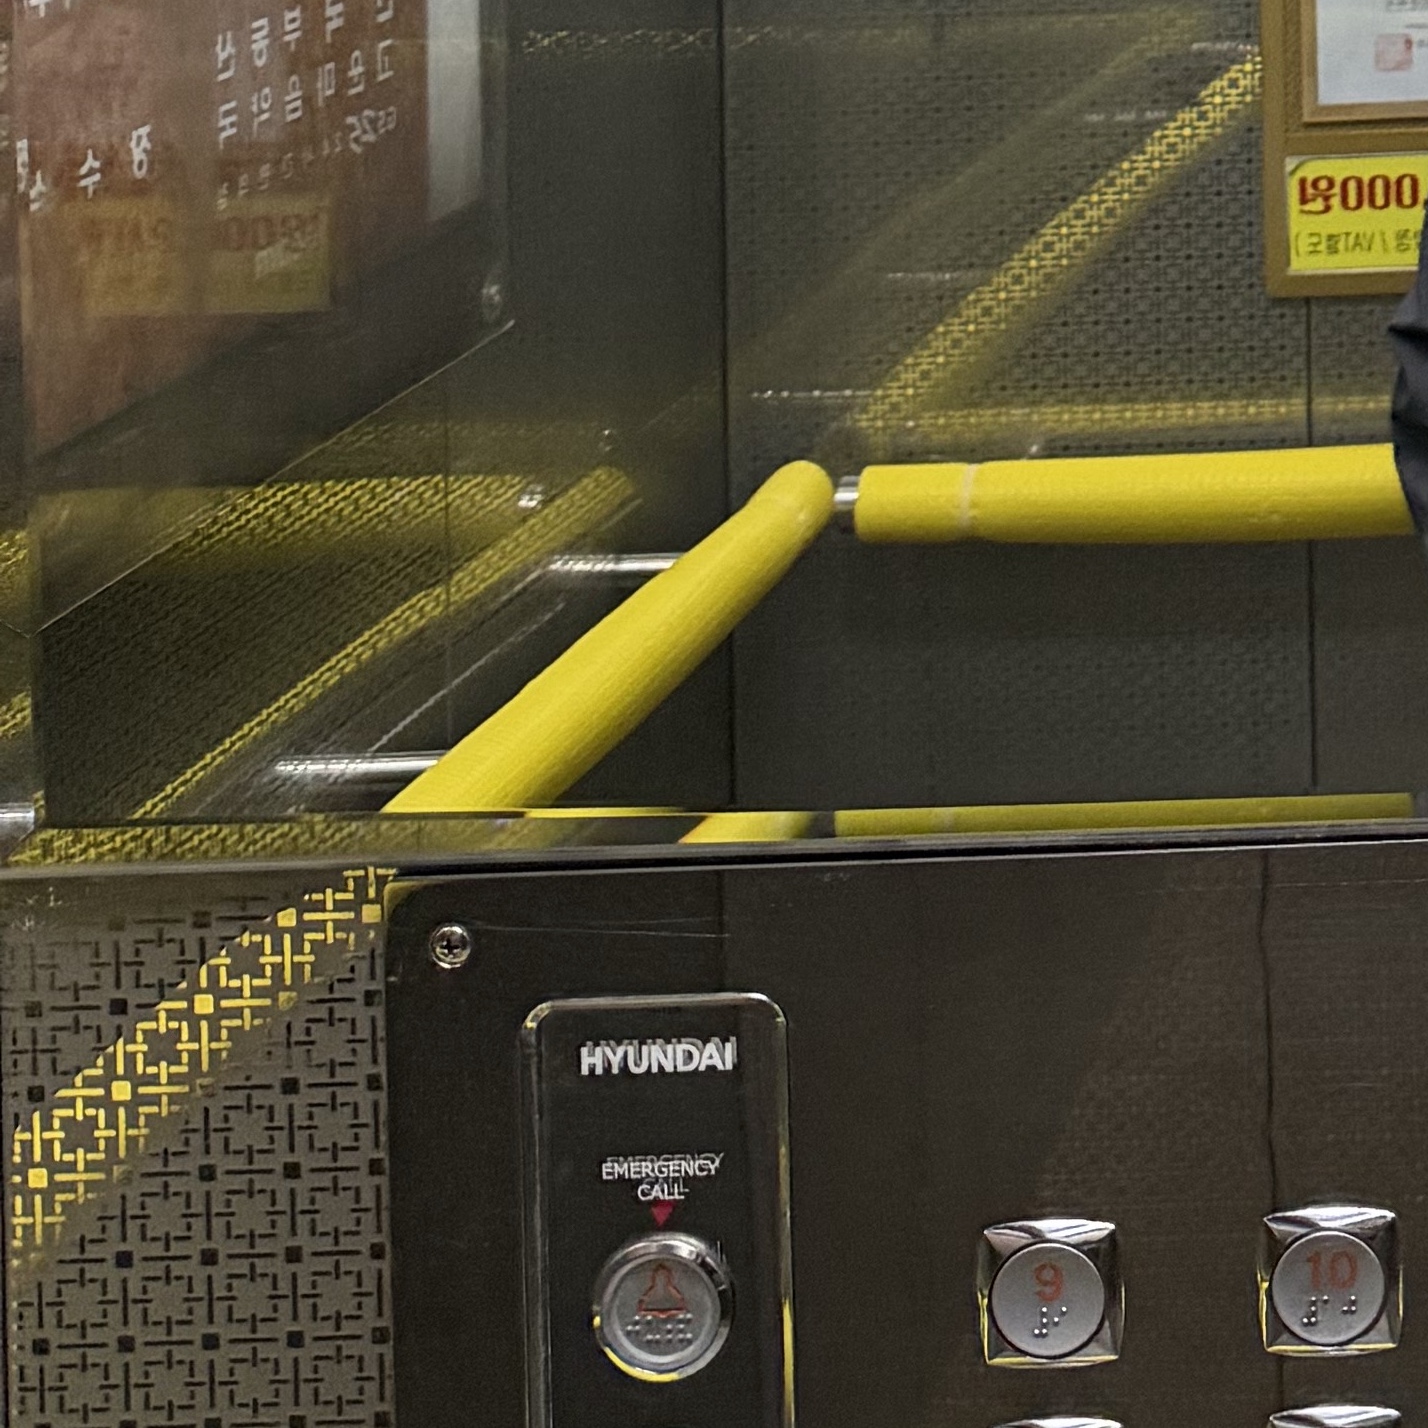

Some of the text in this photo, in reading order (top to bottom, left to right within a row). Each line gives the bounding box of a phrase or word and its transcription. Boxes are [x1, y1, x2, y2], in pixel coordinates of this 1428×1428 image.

[579, 1041, 734, 1076] HYUNDAI
[601, 1159, 720, 1181] EMERGENCY
[637, 1183, 685, 1201] CALL
[1033, 1261, 1063, 1302] 9
[1306, 1249, 1358, 1291] 10
